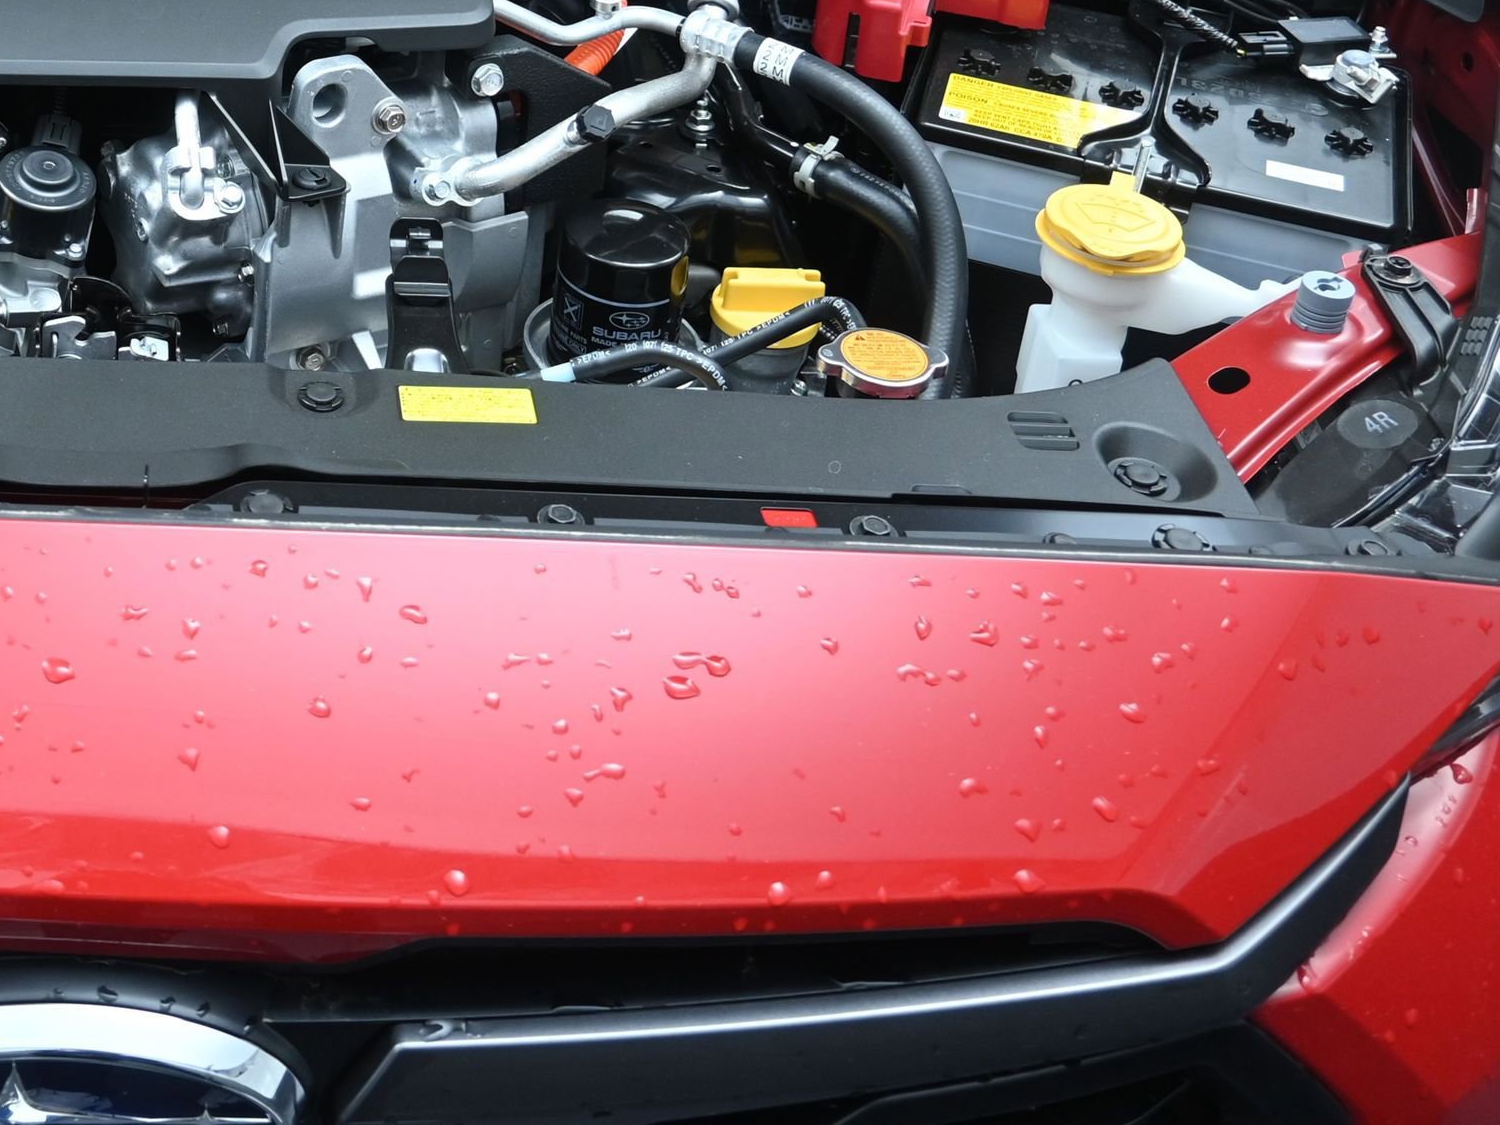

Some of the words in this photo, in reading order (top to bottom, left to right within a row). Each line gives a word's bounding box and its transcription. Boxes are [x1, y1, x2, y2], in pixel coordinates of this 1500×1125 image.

[953, 75, 995, 89] DANGER
[948, 91, 988, 104] POISON
[592, 326, 662, 341] SUBARU
[675, 347, 694, 361] TPC
[1364, 411, 1399, 433] 4R
